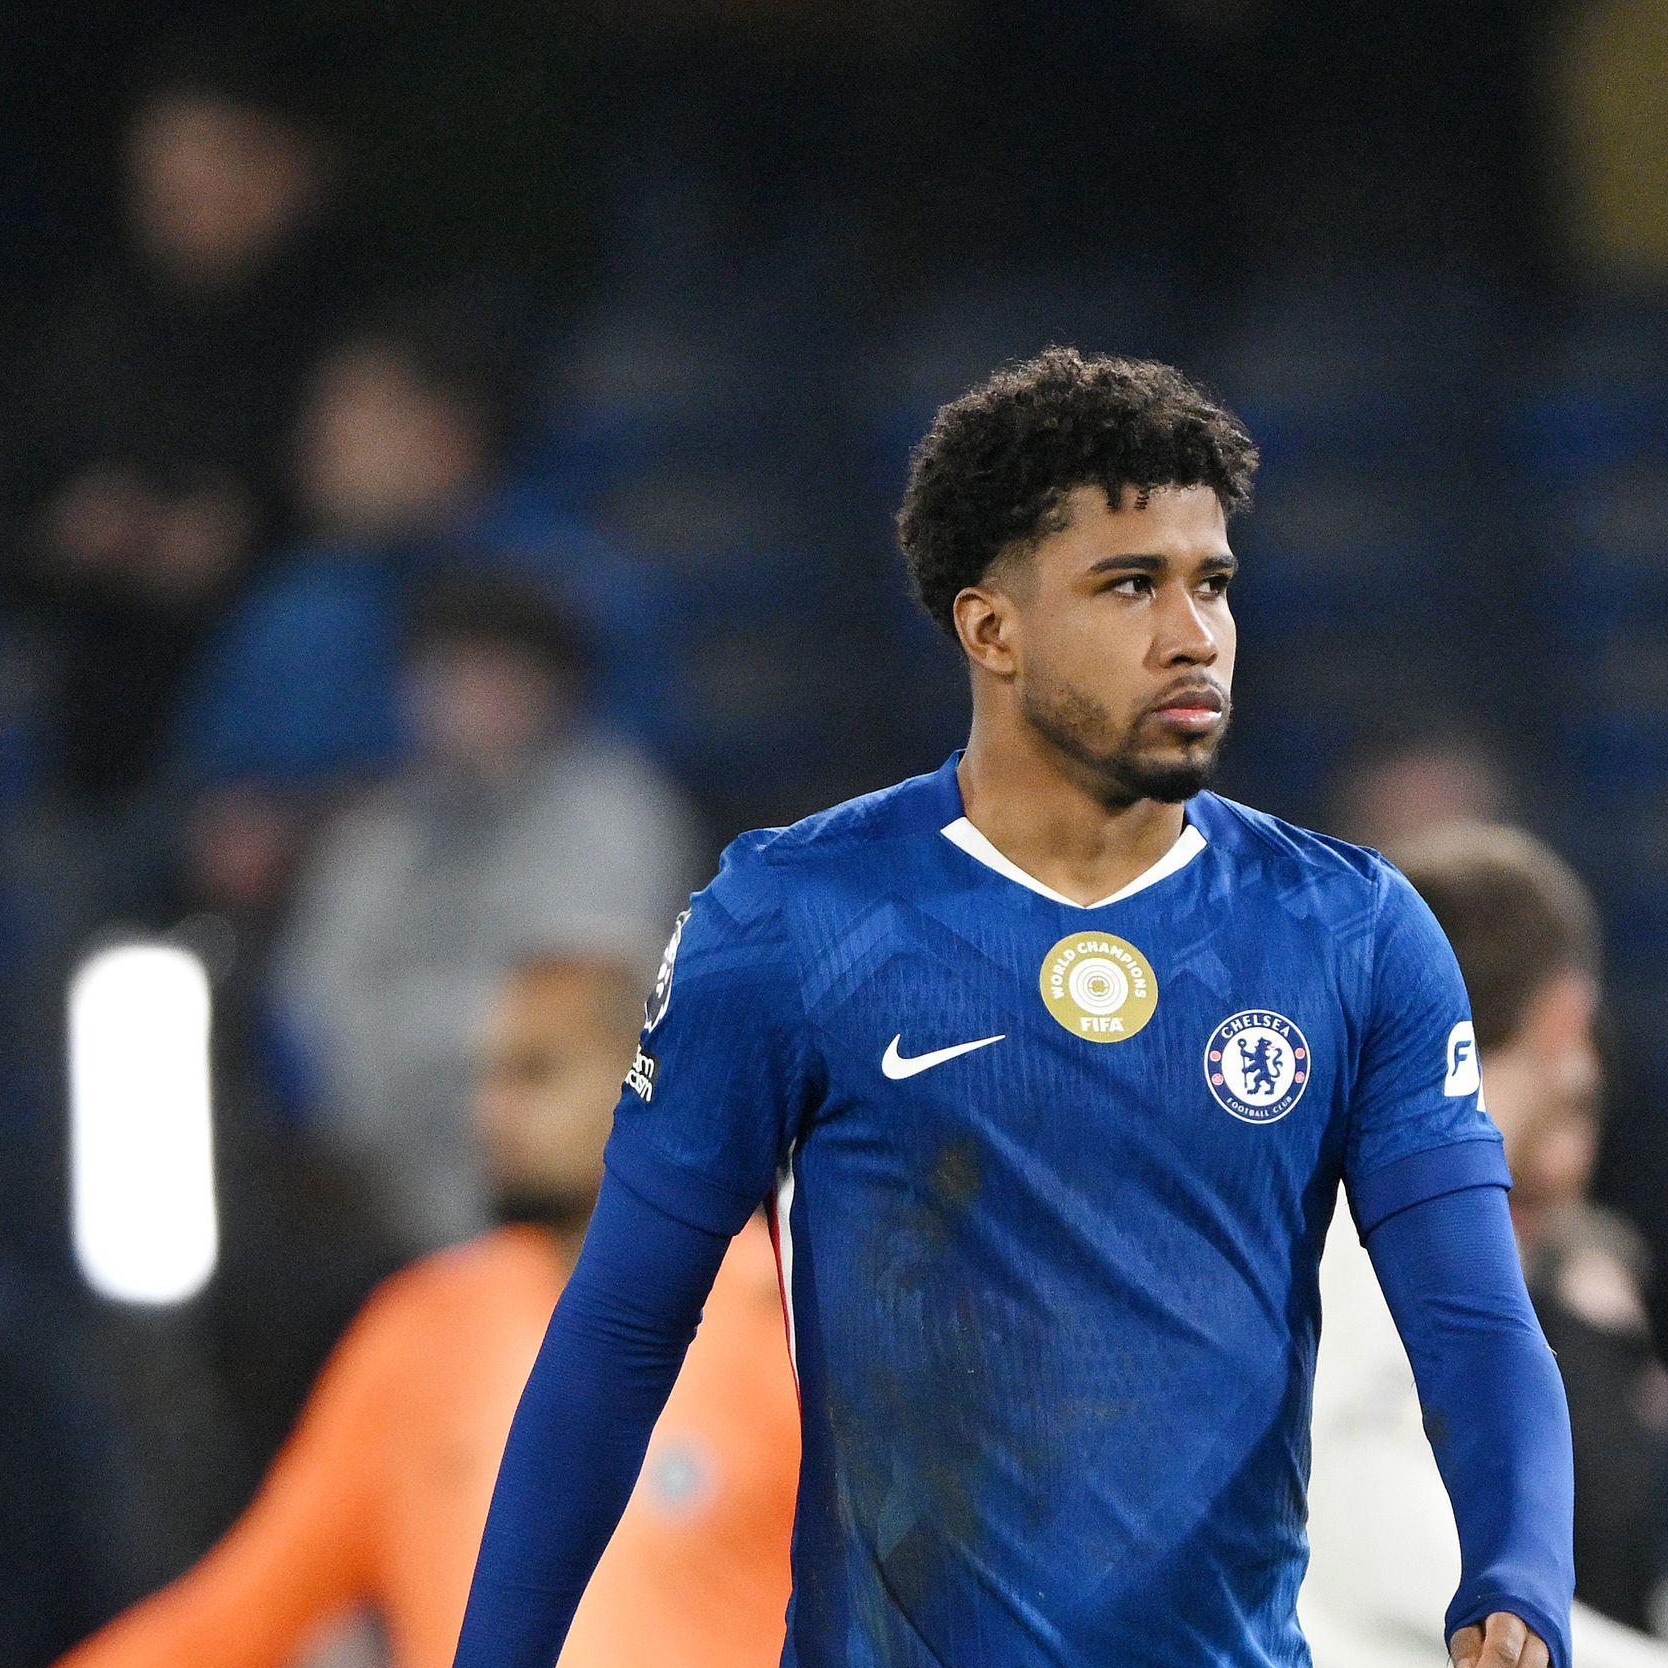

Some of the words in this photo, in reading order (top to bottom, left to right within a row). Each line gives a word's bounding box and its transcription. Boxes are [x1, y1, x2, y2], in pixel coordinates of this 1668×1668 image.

[1050, 950, 1076, 999] WORLD
[1077, 941, 1147, 999] CHAMPIONS
[1080, 1017, 1124, 1033] FIFA
[1221, 1014, 1290, 1039] CHELSEA
[1227, 1097, 1269, 1117] FOOTBALL
